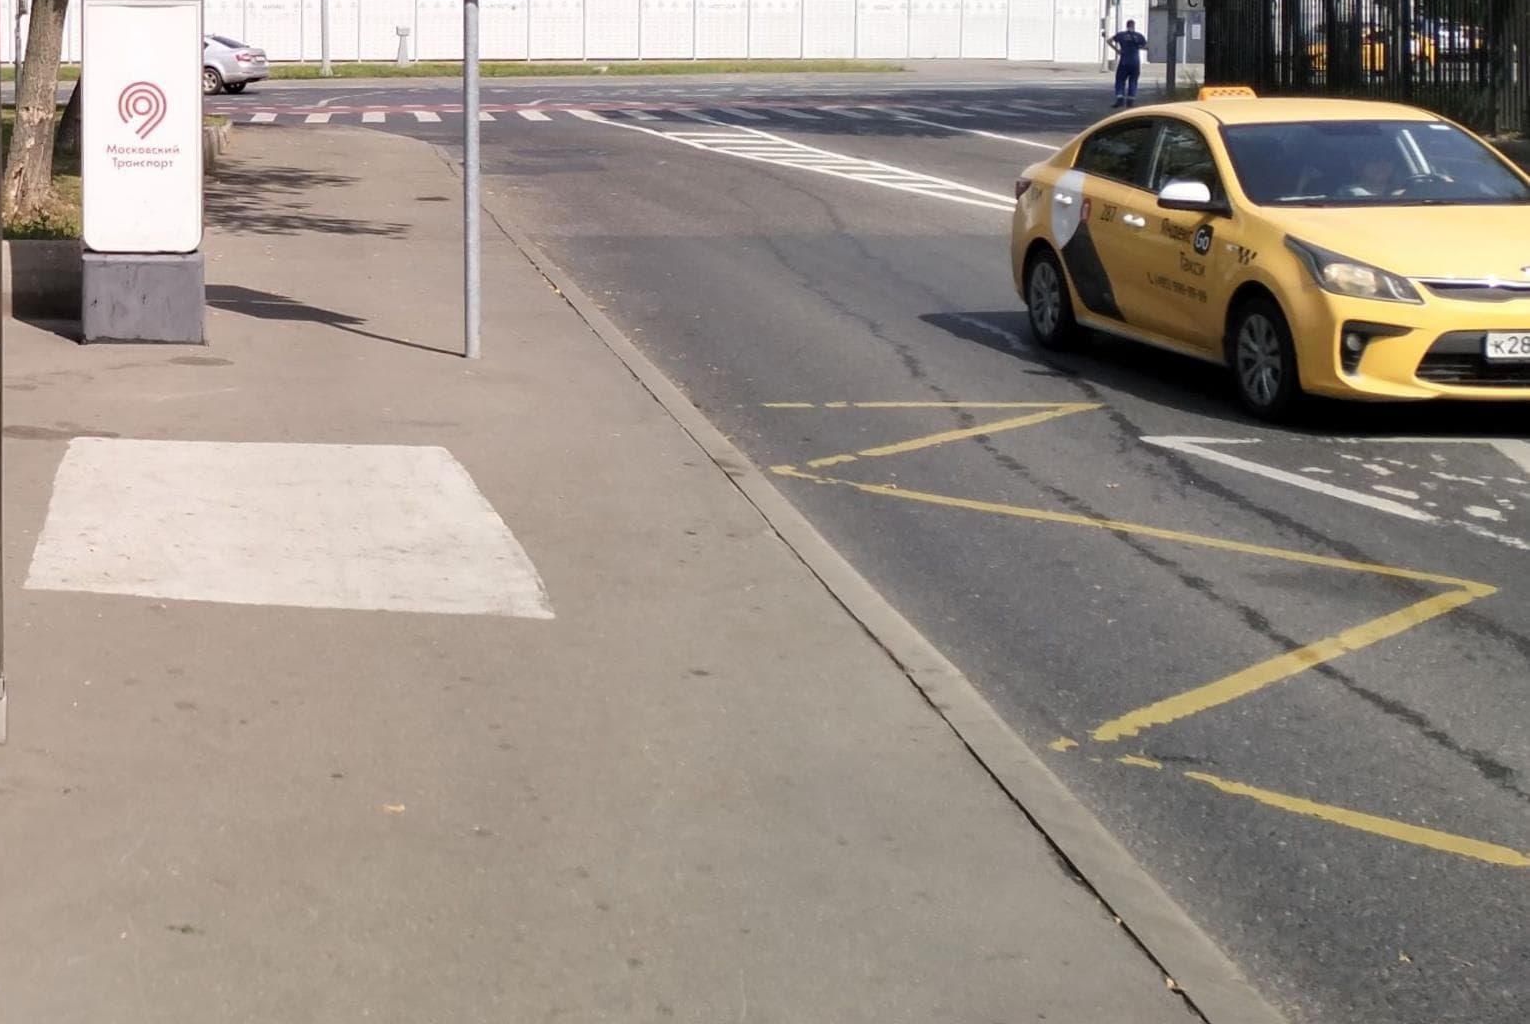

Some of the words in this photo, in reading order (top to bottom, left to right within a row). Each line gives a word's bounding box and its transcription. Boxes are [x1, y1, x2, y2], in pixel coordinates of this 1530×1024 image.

[106, 144, 180, 155] Московский
[113, 157, 174, 170] Транспорт
[1195, 228, 1210, 251] Go
